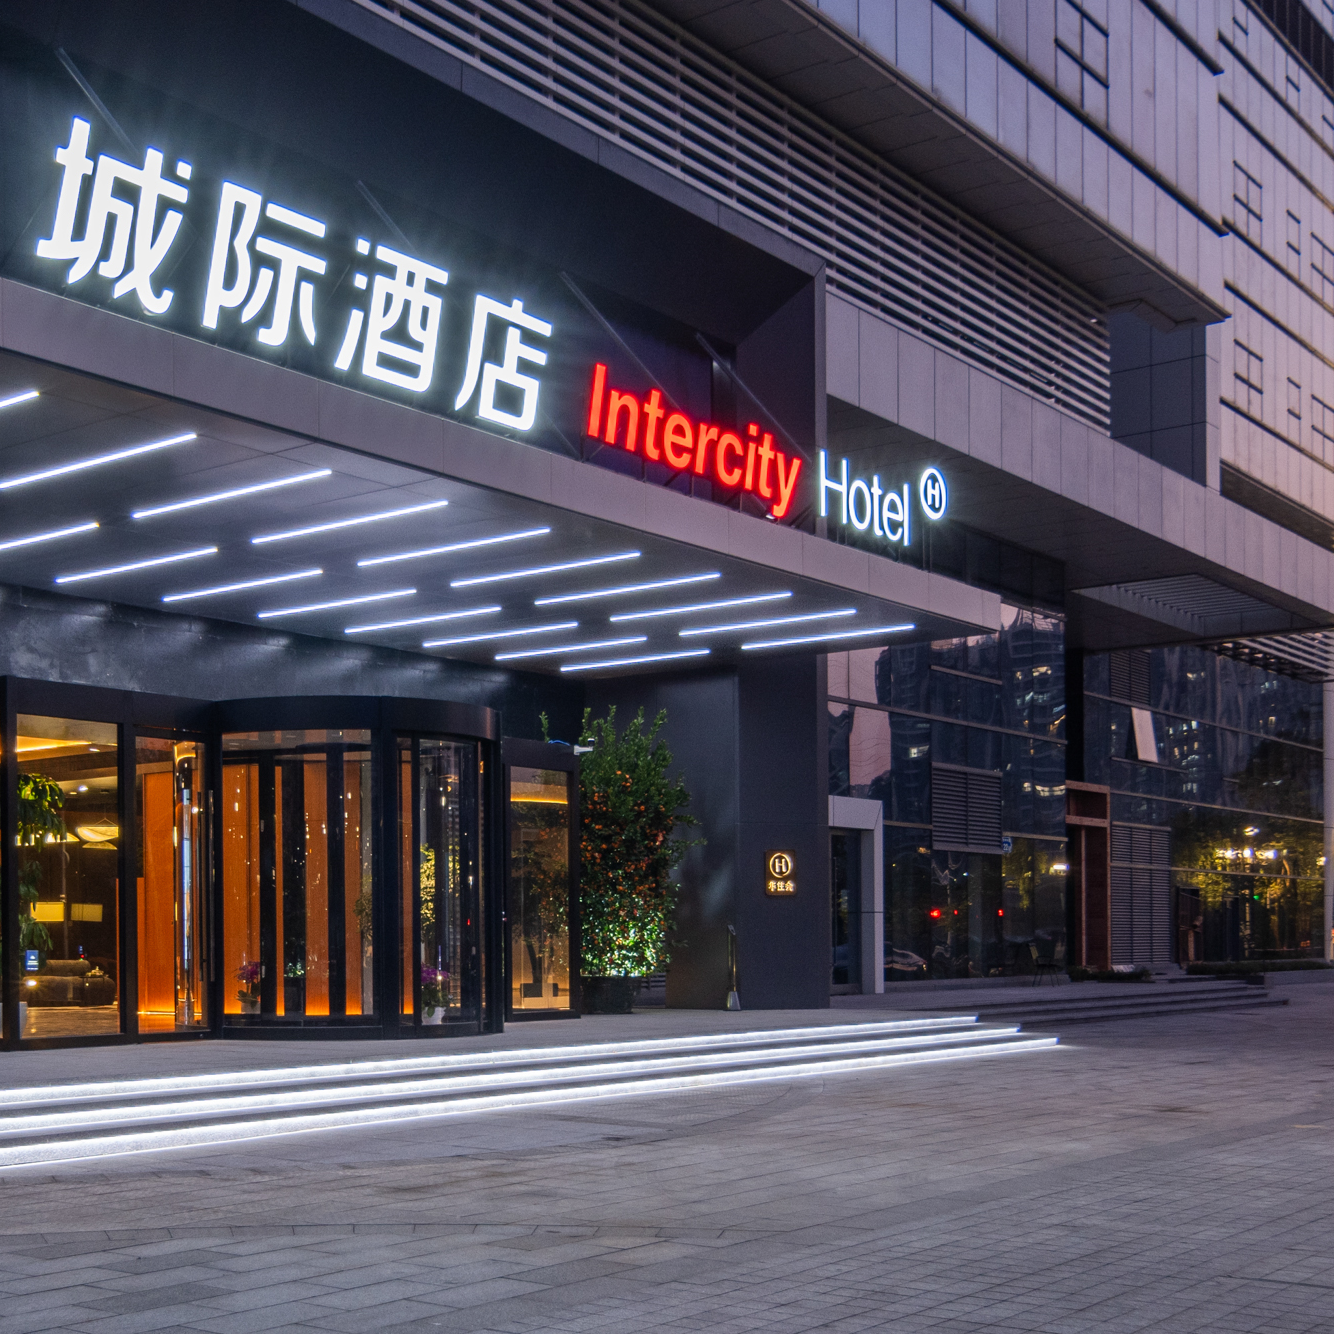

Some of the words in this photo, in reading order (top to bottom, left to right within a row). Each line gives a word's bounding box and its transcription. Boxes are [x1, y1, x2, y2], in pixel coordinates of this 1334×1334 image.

[36, 116, 553, 432] 城际酒店
[585, 361, 803, 520] Intercity
[819, 449, 910, 546] Hotel
